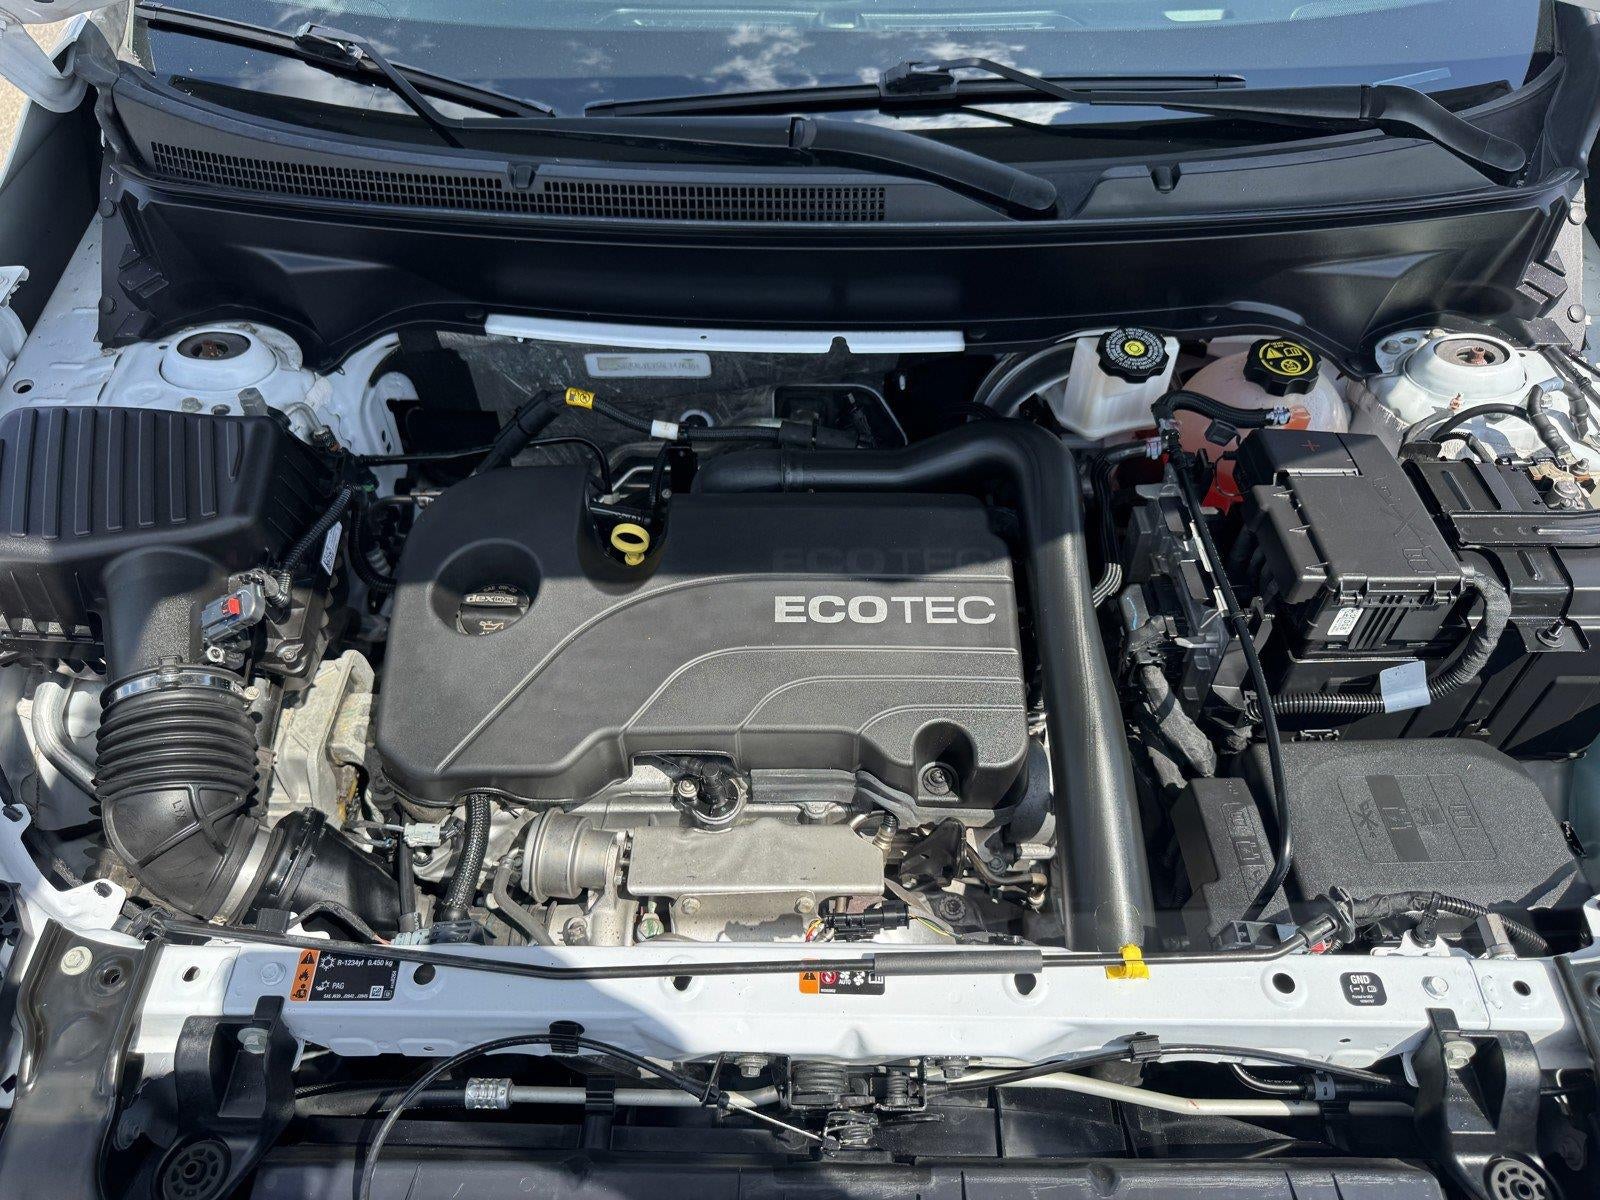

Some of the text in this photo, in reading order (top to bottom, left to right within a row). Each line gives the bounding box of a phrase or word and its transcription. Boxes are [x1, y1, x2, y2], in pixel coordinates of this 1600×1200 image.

[774, 595, 997, 625] ECOTEC
[336, 959, 393, 967] R-1234yf 0.450 kg
[1350, 974, 1370, 984] GND
